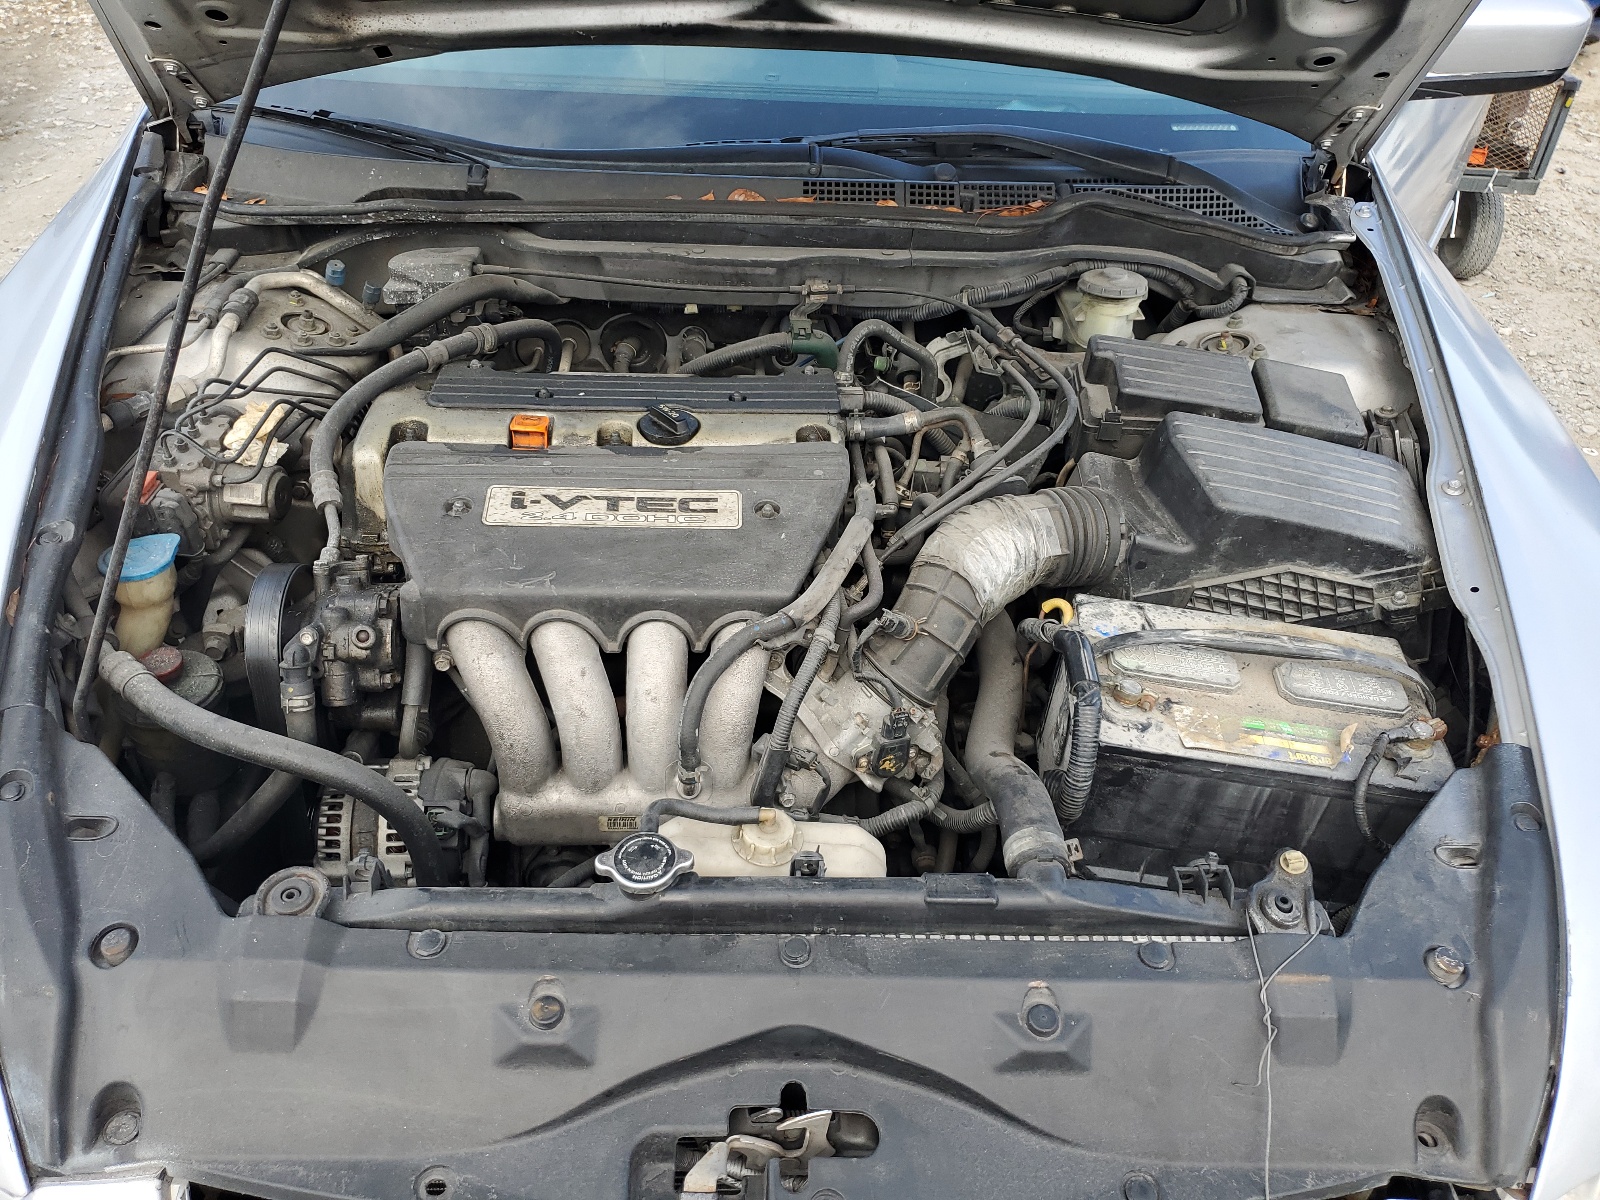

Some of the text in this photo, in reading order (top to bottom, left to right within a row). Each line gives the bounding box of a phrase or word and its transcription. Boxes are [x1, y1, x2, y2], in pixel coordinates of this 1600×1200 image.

[510, 490, 719, 513] i-VTEC
[521, 511, 707, 524] 2.4 DOHC
[631, 873, 659, 882] CAUTION
